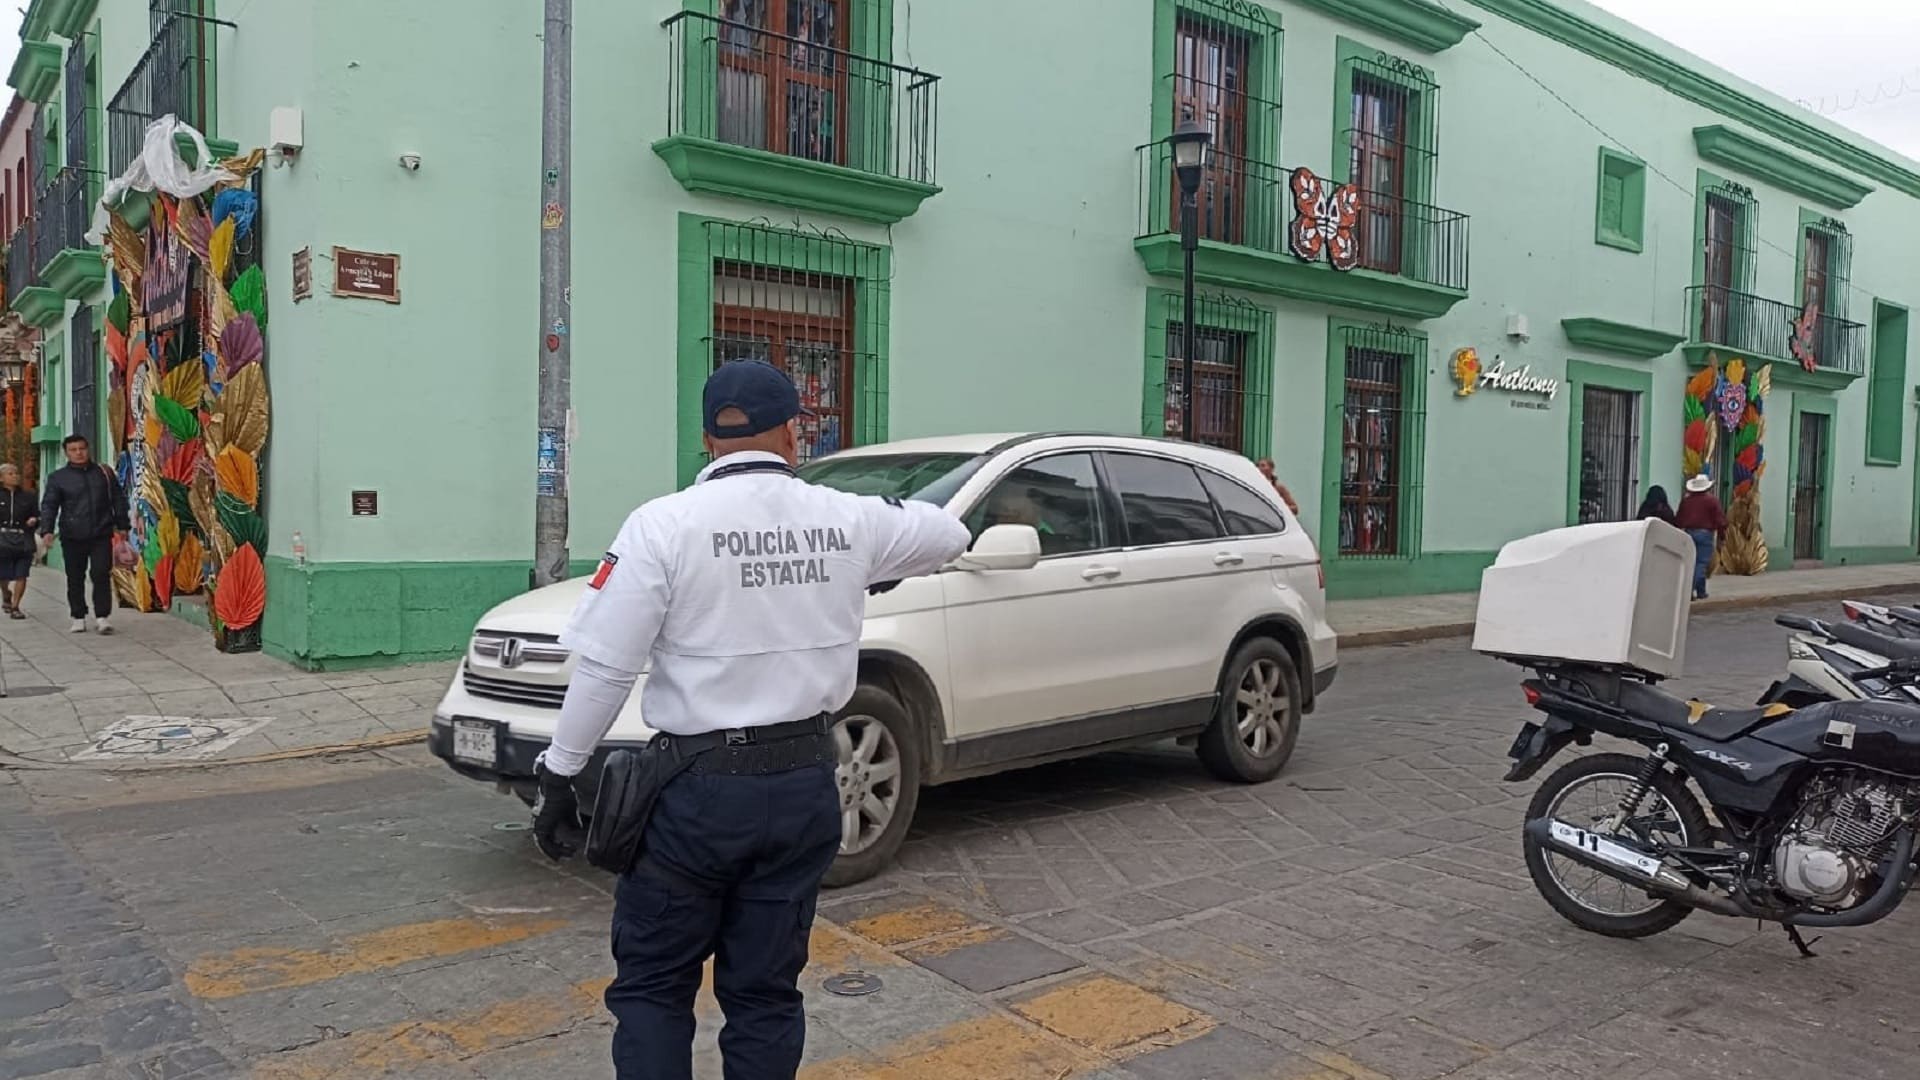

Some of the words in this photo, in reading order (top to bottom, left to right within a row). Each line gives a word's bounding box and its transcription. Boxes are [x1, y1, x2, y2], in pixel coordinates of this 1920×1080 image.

[1480, 360, 1558, 400] Anthony
[712, 525, 799, 557] POLICÍA
[803, 527, 851, 553] VIAL
[740, 558, 830, 588] ESTATAL
